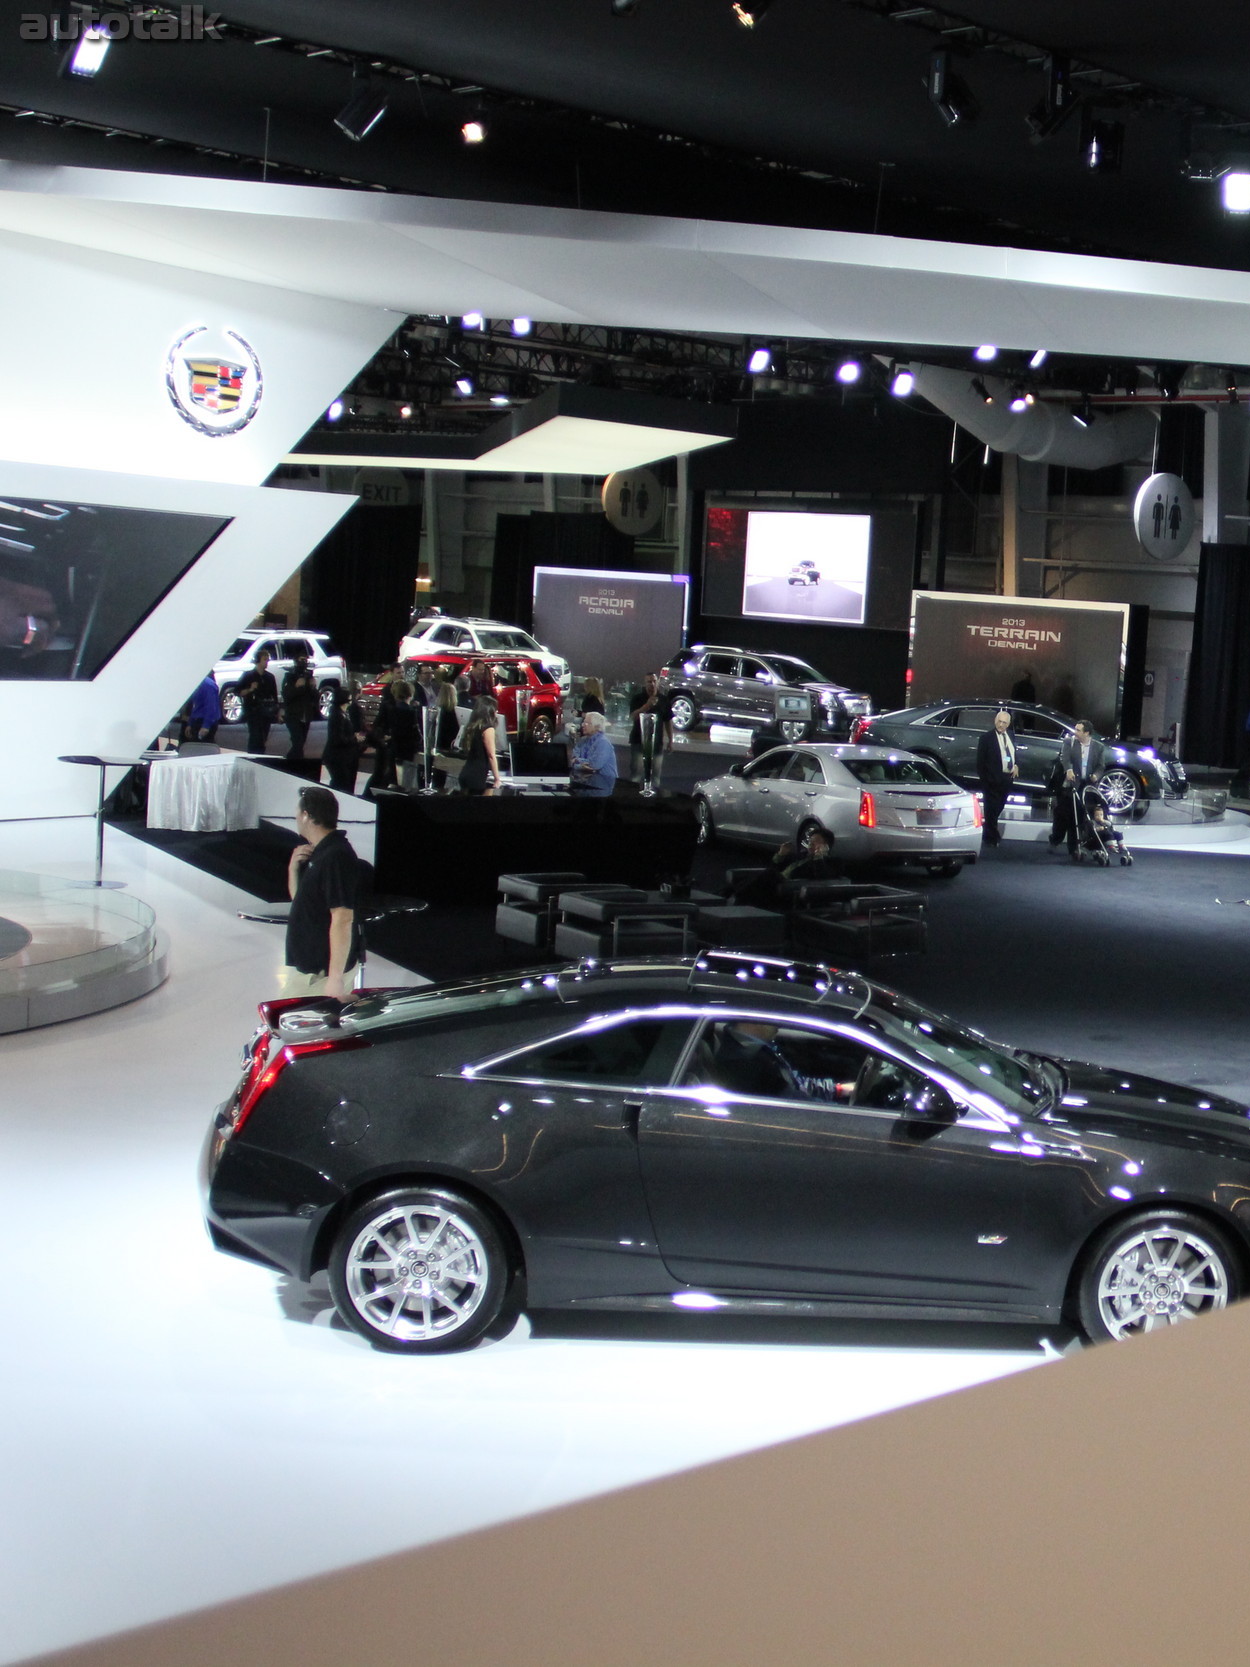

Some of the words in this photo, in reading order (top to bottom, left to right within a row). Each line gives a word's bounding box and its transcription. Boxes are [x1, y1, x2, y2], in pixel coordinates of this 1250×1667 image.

[362, 483, 402, 503] EXIT
[579, 596, 634, 608] ACADIA
[588, 607, 623, 615] DENALI
[1002, 618, 1026, 627] 2013
[967, 625, 1061, 642] TERRAIN
[988, 640, 1037, 650] DENALI
